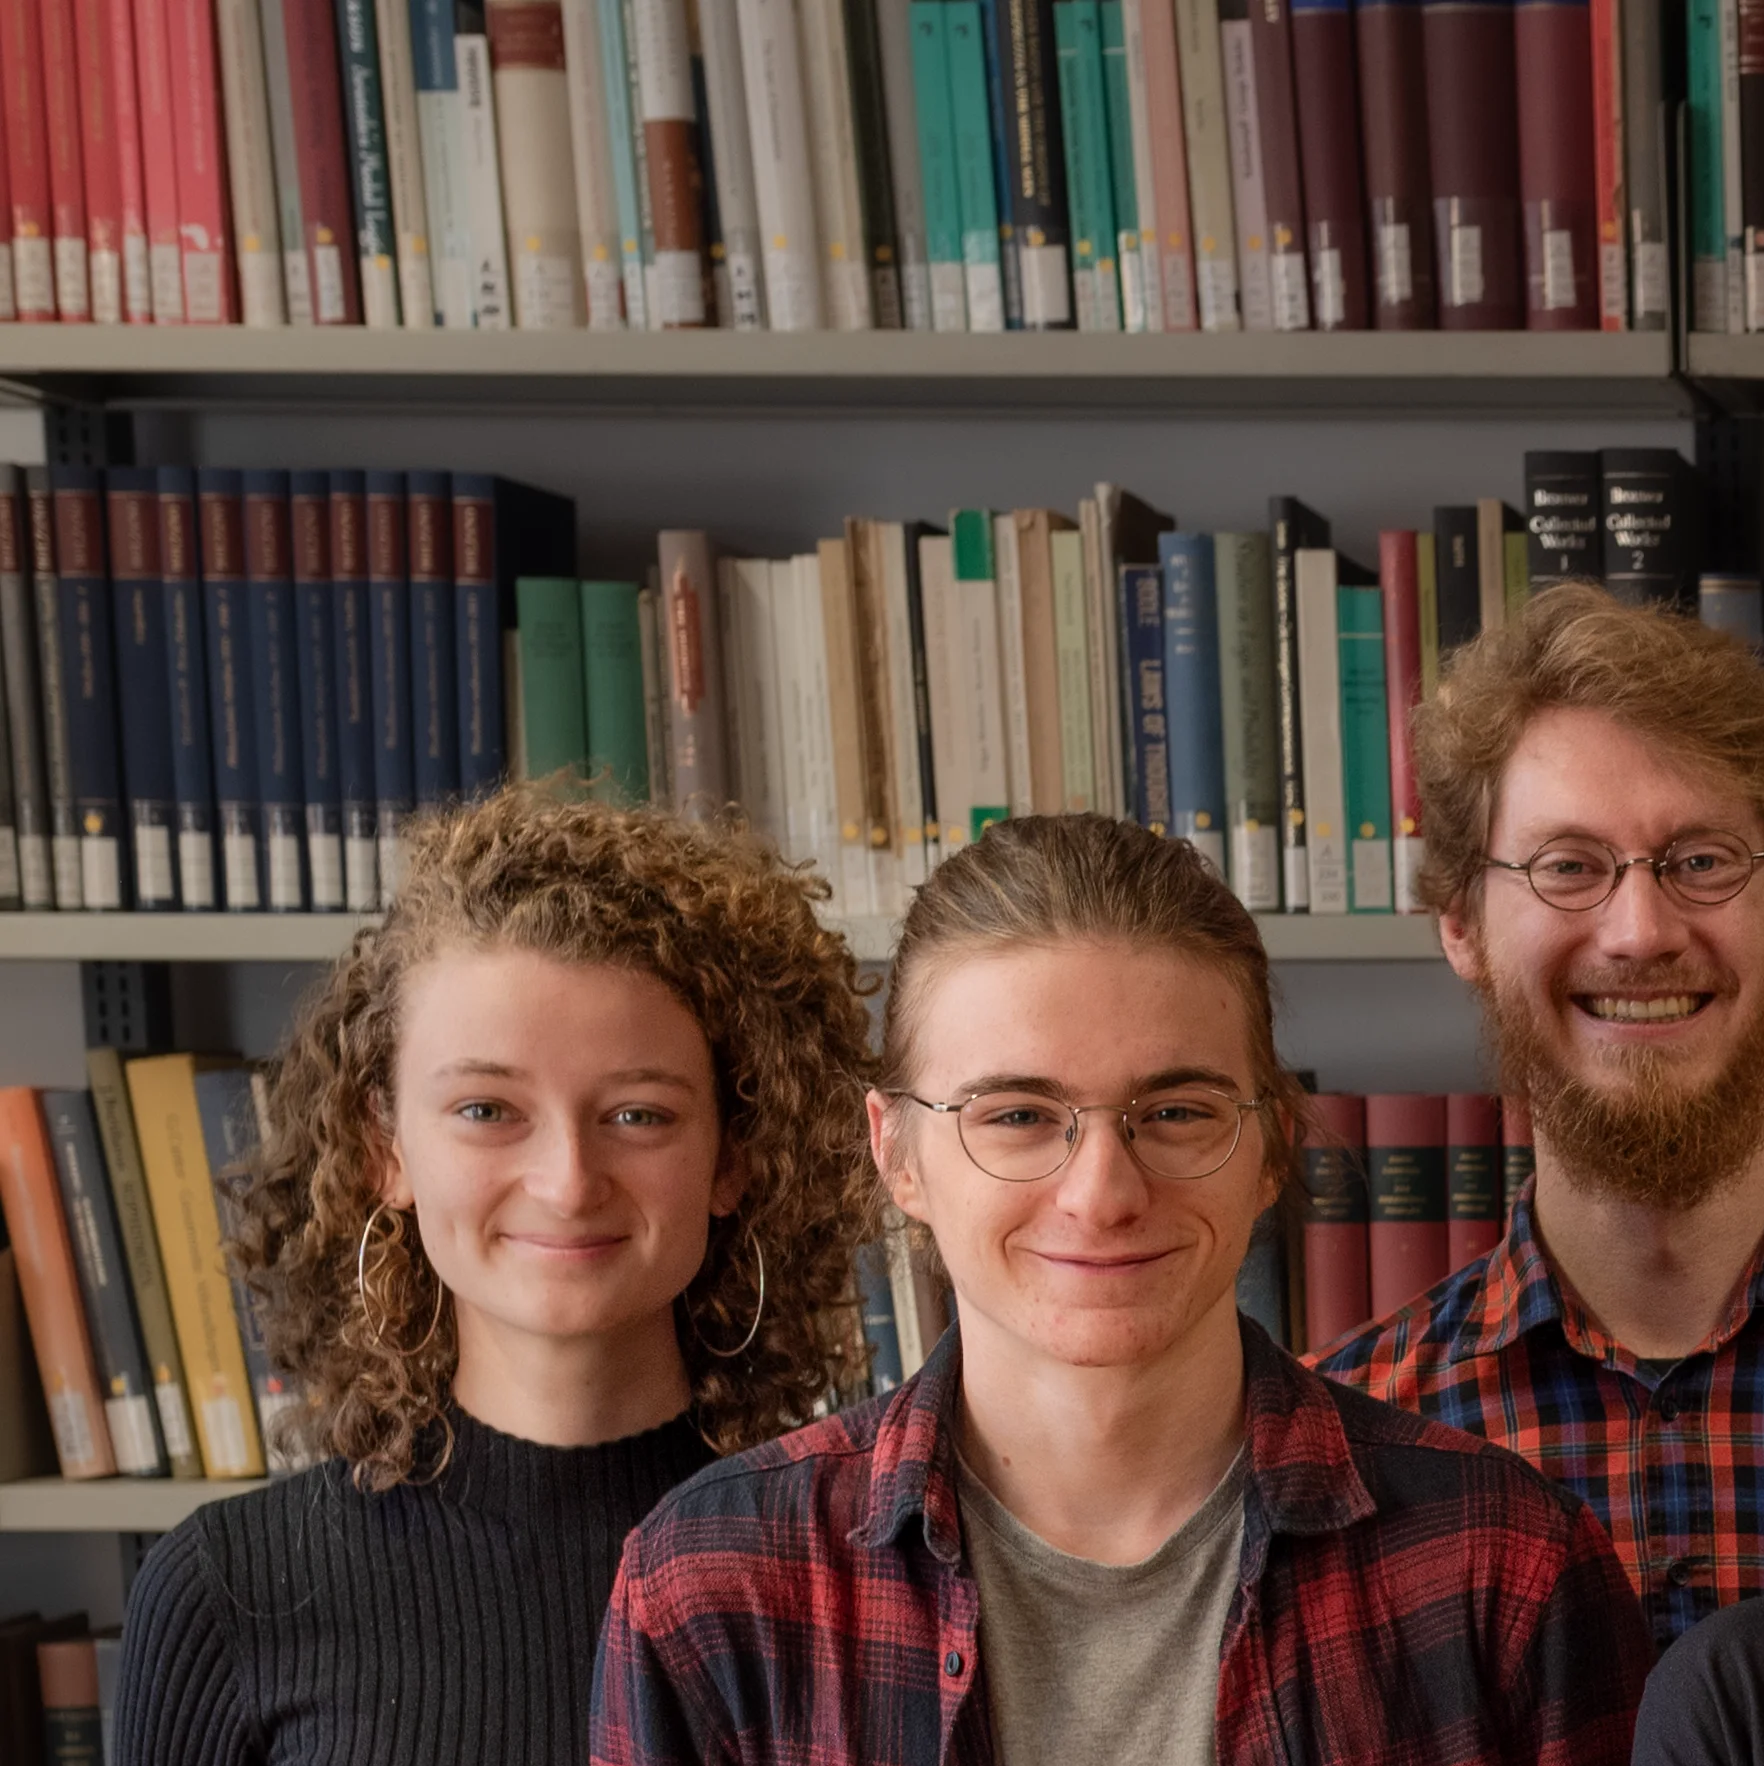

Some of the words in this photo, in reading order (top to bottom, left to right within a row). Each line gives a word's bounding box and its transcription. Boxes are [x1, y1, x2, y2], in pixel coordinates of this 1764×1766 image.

[1528, 515, 1597, 534] Collected
[1605, 512, 1671, 532] Collected
[1539, 533, 1586, 550] Works
[1614, 530, 1662, 548] Works
[1631, 549, 1645, 571] 2
